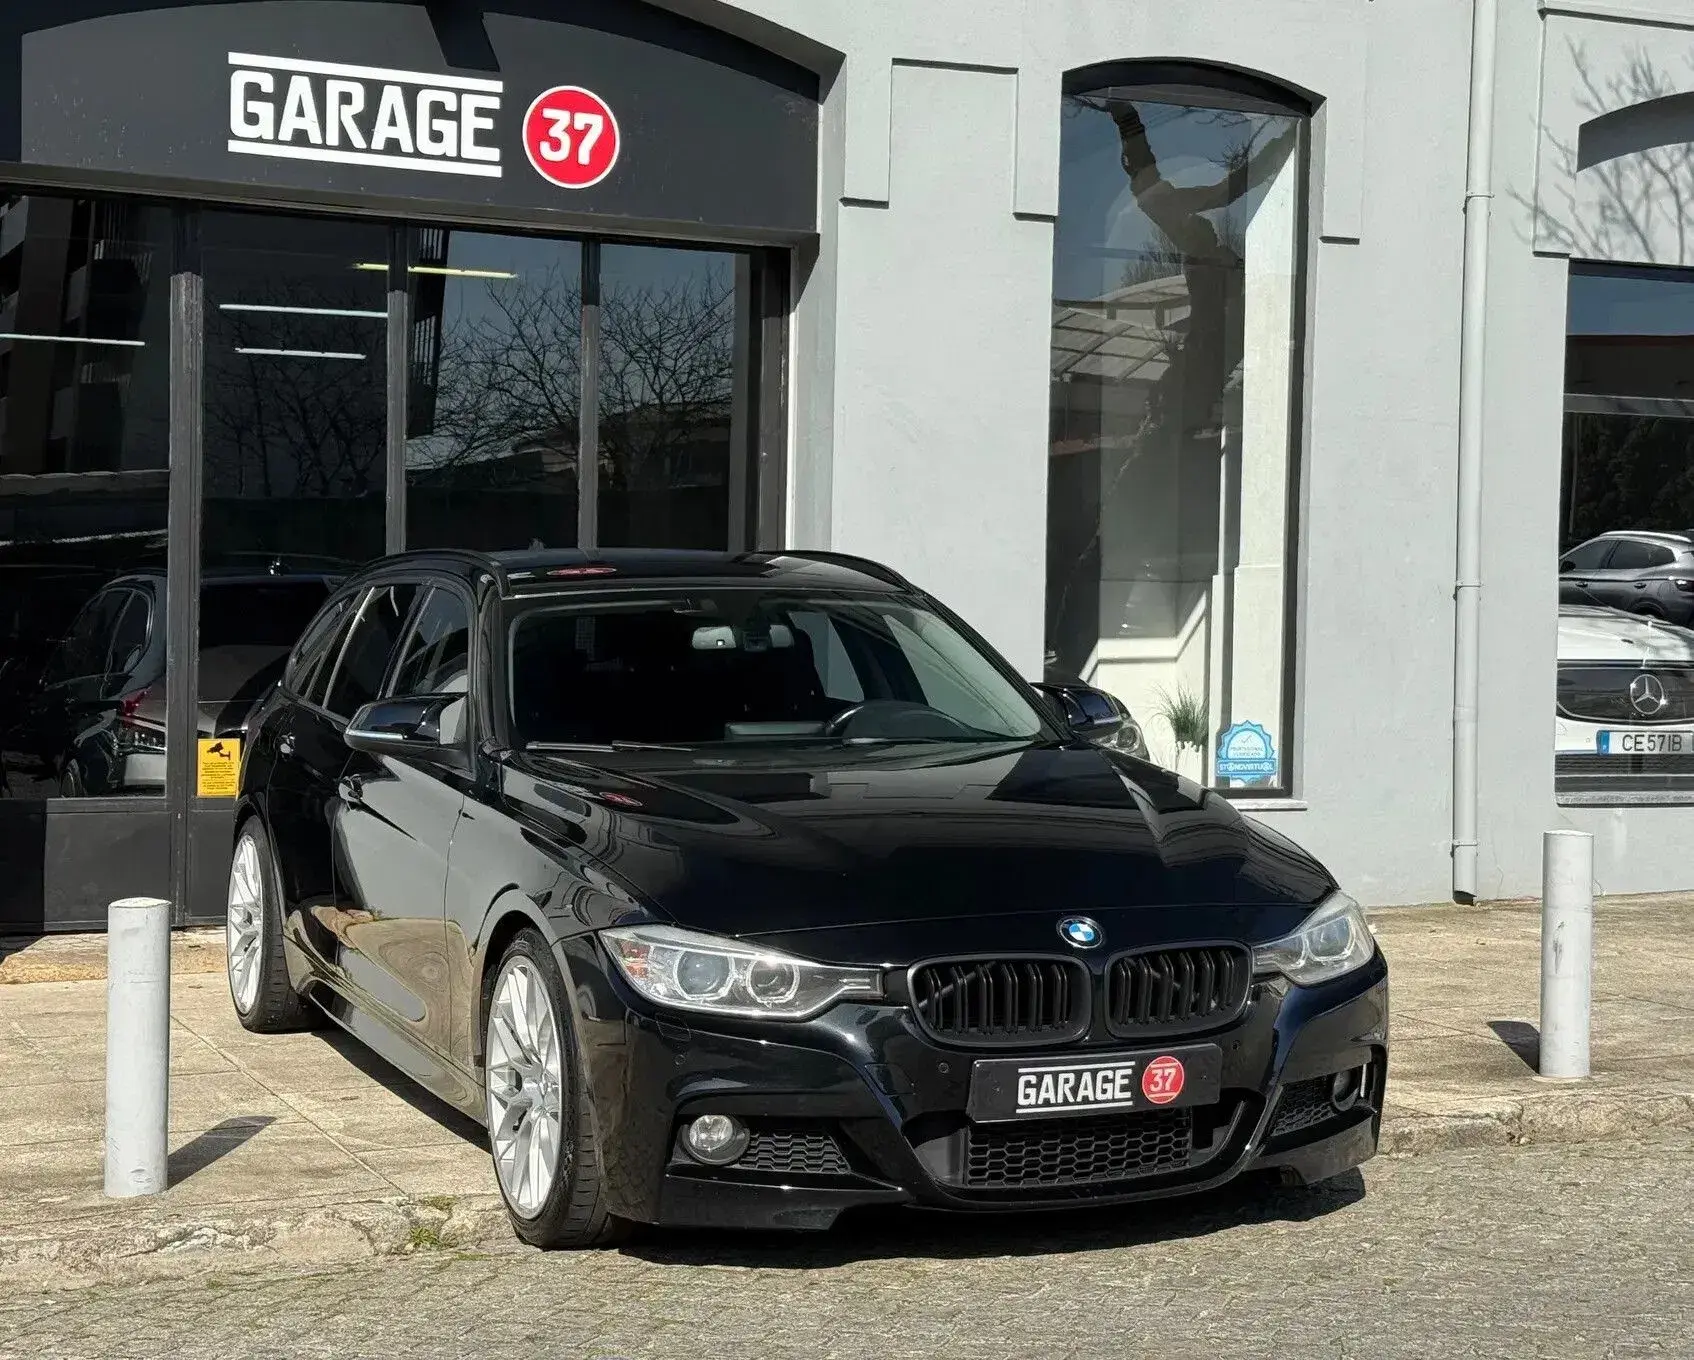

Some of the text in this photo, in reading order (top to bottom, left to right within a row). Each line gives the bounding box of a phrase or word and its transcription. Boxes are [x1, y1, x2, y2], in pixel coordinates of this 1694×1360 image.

[230, 69, 604, 166] GARAGE 37
[1017, 1067, 1177, 1106] GARAGE 37
